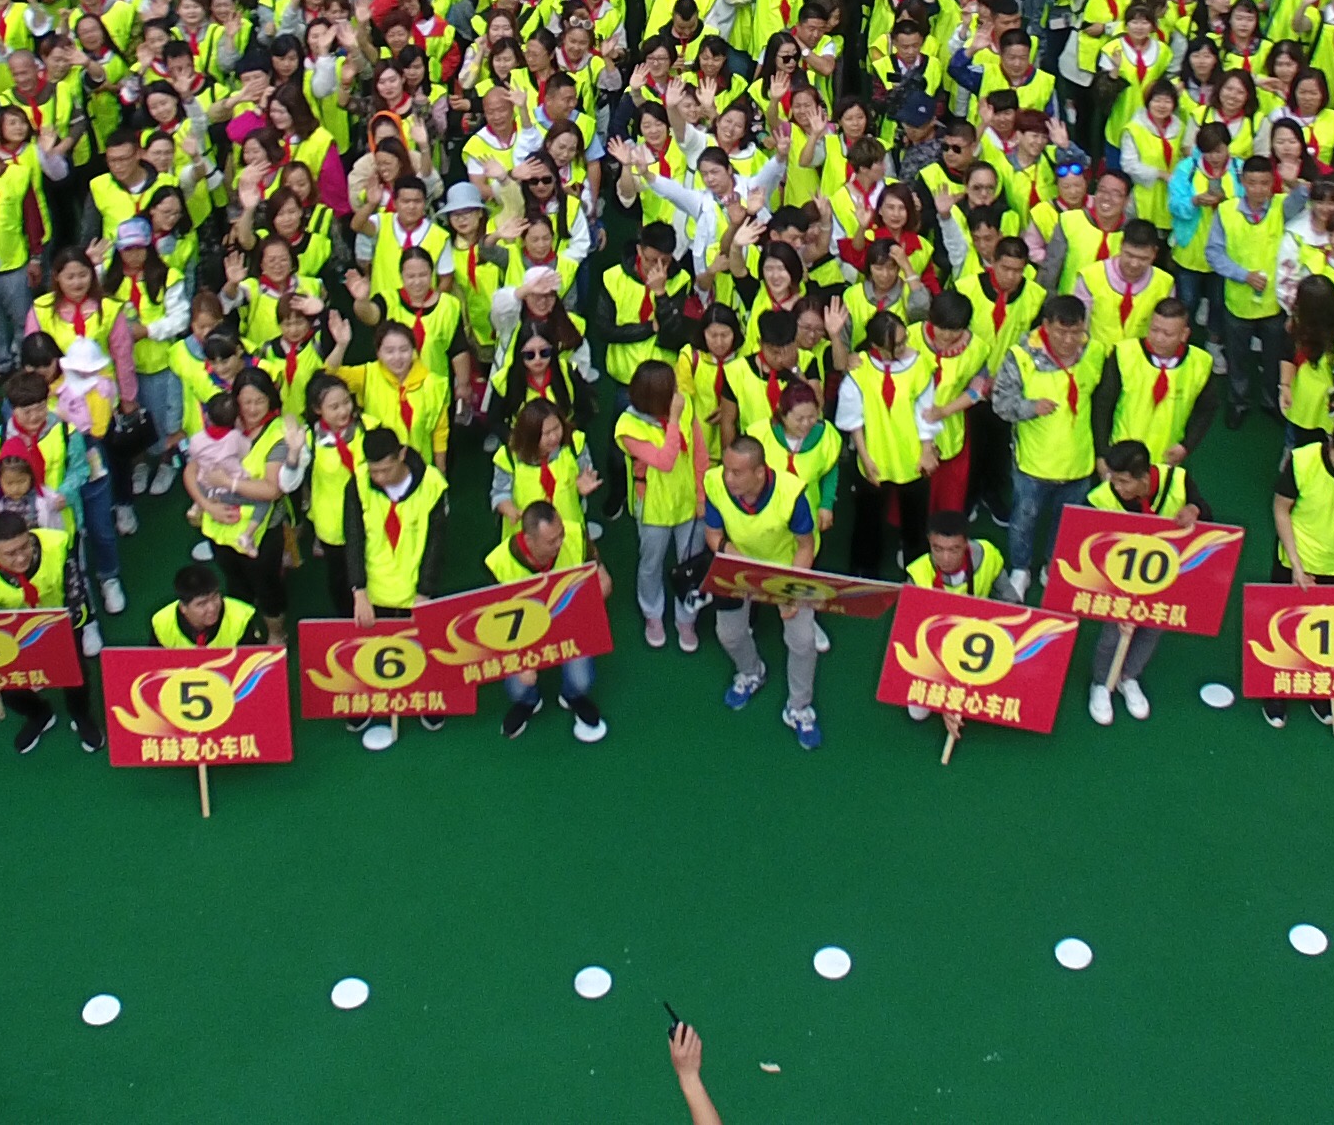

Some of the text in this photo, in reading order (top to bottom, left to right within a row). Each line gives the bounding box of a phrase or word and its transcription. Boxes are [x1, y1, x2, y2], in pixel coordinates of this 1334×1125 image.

[1118, 548, 1169, 583] 10
[493, 607, 525, 641] 7
[1071, 590, 1187, 628] 尚赫爱心车队
[373, 646, 406, 680] 6
[462, 639, 581, 684] 尚赫爱心车队
[959, 633, 994, 673] 9
[180, 681, 213, 721] 5
[332, 690, 446, 714] 尚赫爱心车队
[907, 678, 1021, 723] 尚赫爱心车队
[141, 735, 260, 762] 尚赫爱心车队
